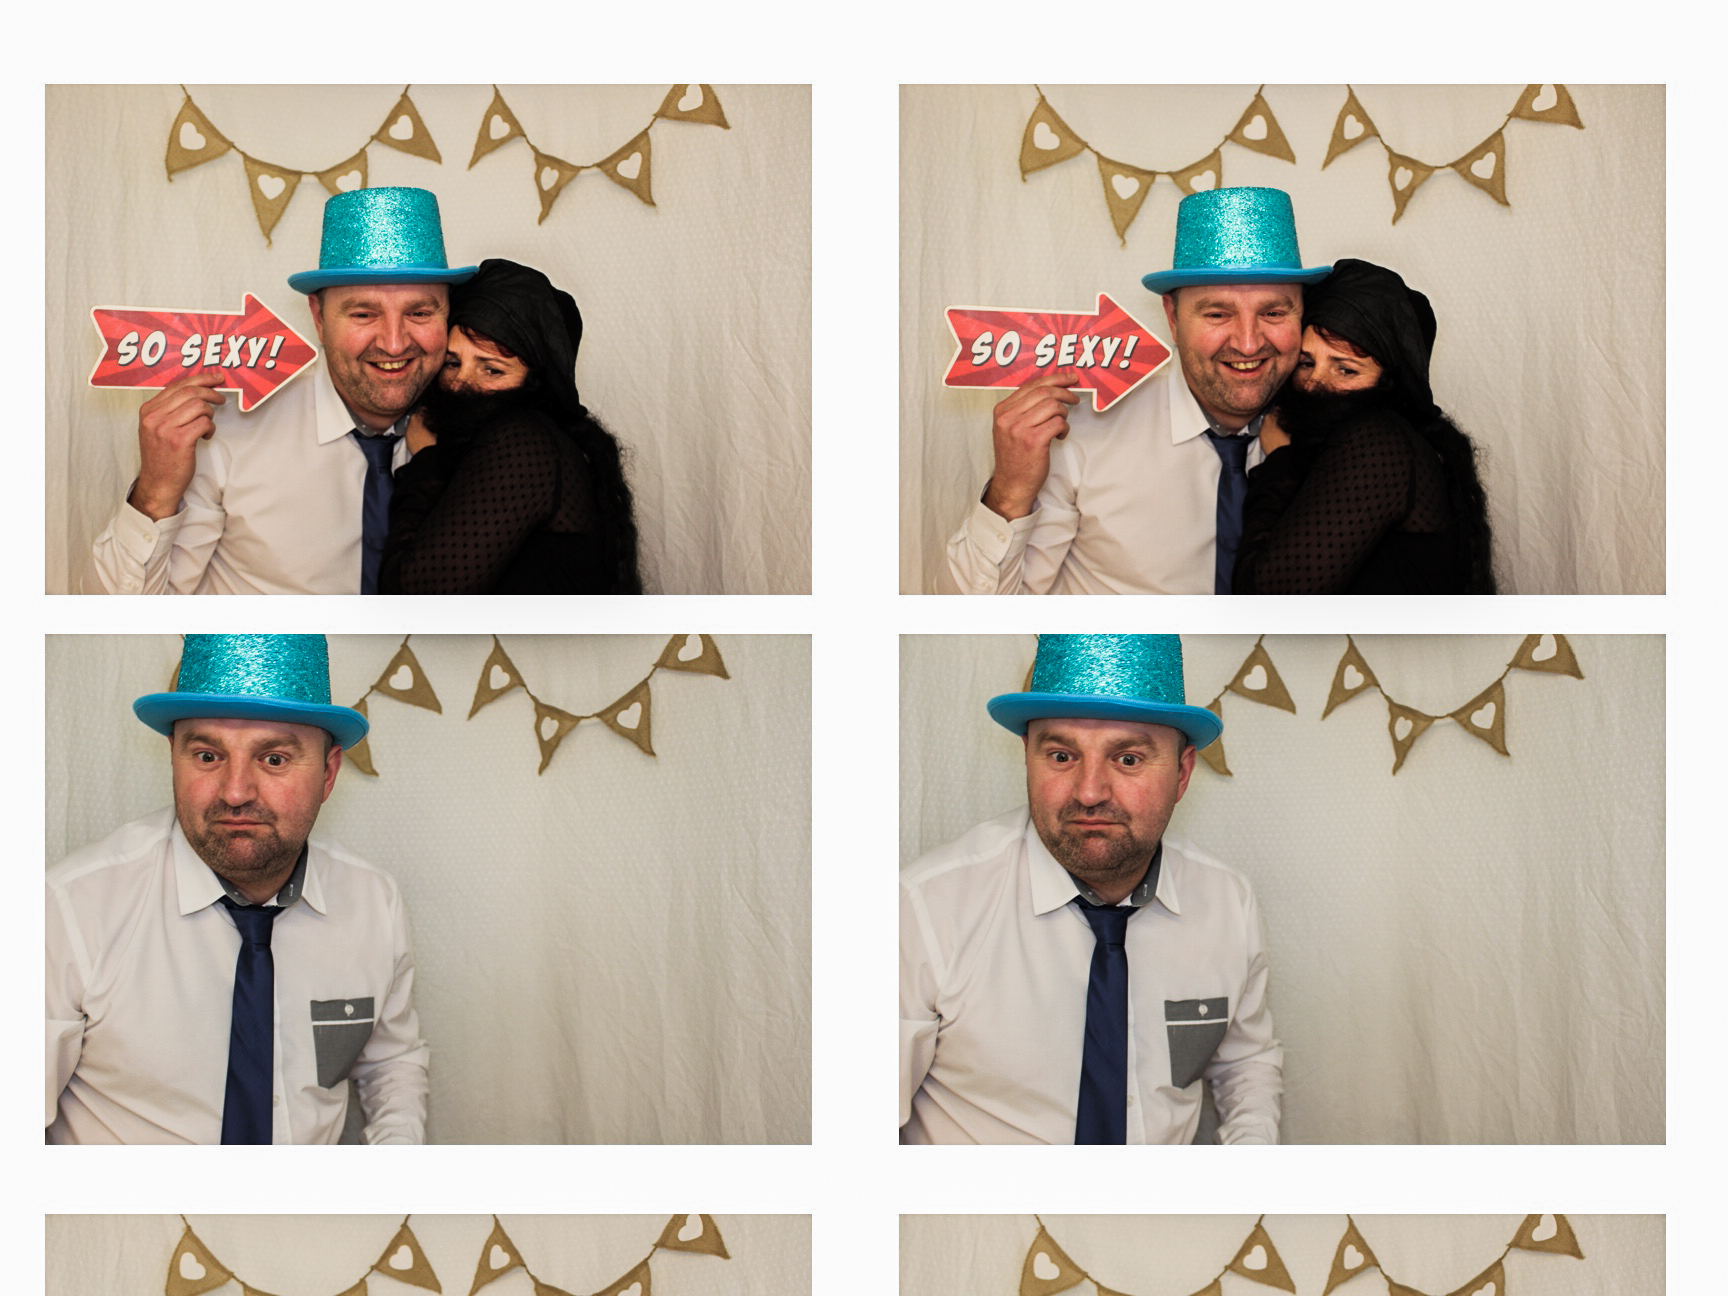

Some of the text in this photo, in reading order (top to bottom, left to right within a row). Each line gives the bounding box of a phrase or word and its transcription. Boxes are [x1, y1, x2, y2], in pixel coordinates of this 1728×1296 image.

[117, 330, 286, 370] SO SEXY!
[971, 330, 1140, 370] SO SEXY!
